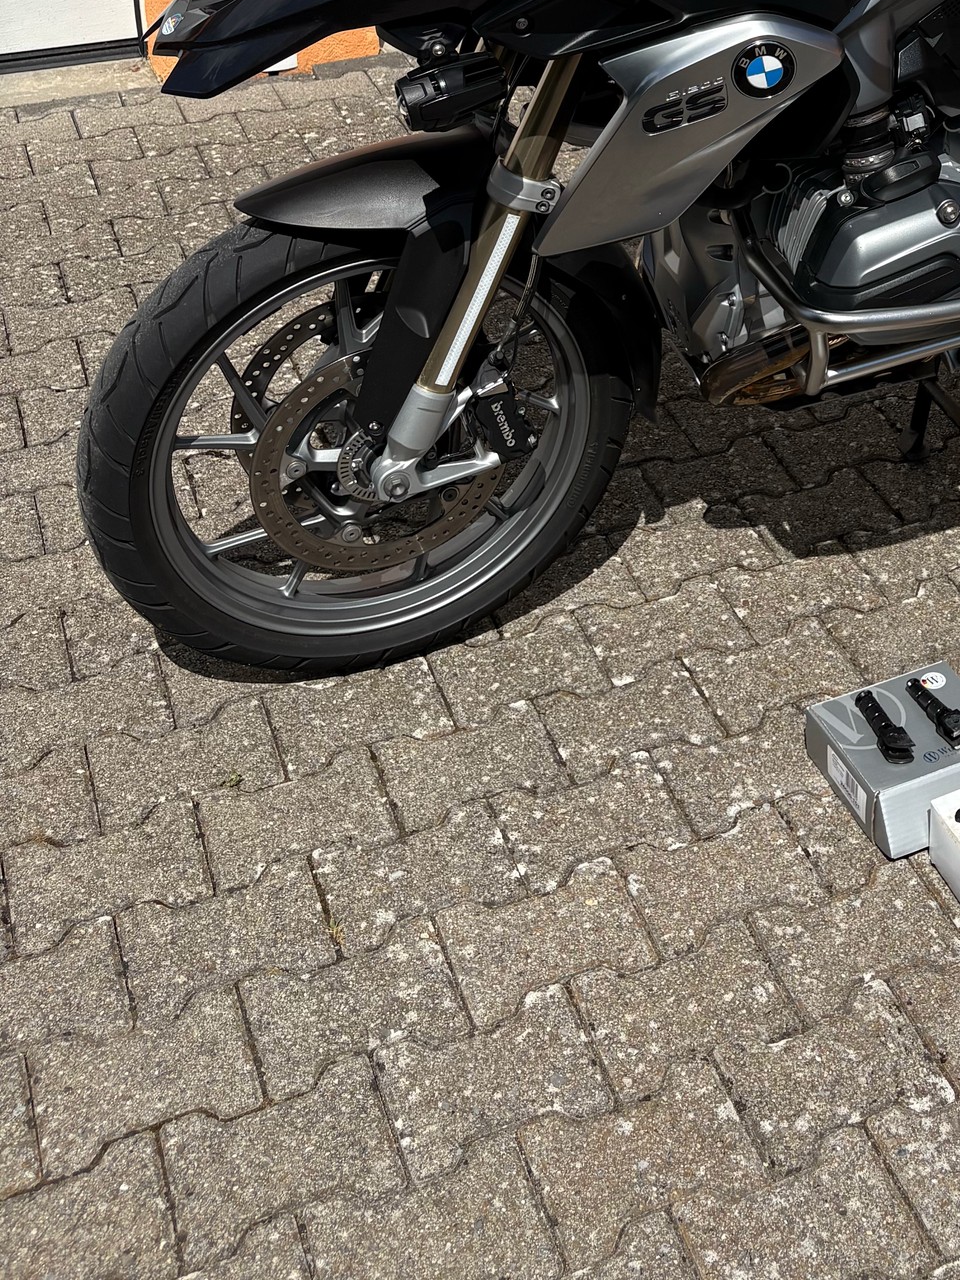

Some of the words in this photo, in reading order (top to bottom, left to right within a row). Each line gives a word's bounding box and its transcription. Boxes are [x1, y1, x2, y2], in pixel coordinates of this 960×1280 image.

[738, 45, 787, 68] BMW
[642, 84, 727, 135] GS
[490, 400, 516, 447] brembo
